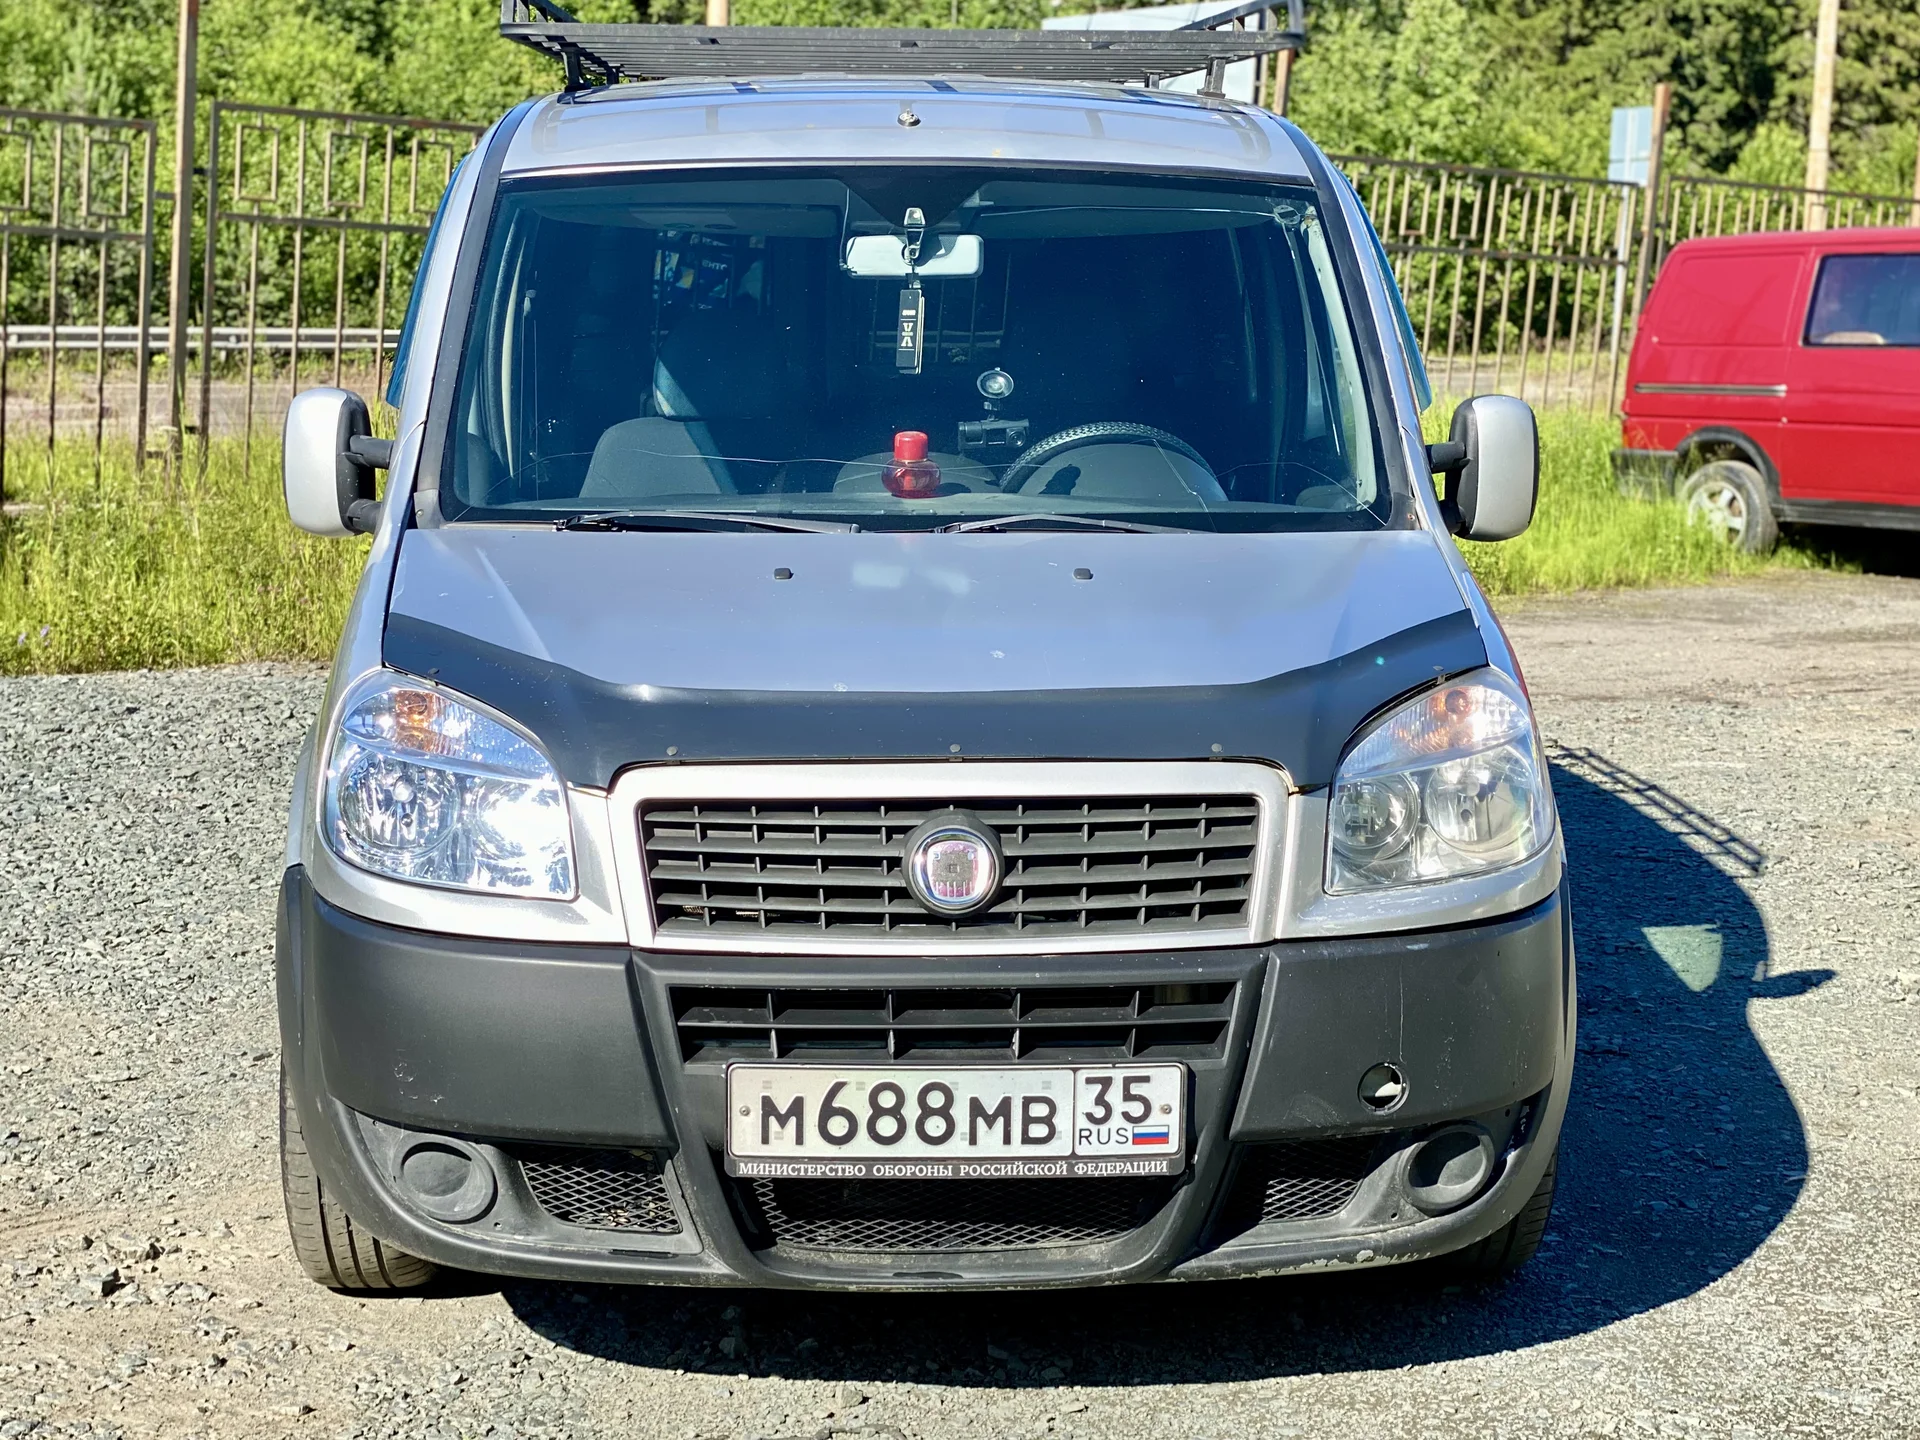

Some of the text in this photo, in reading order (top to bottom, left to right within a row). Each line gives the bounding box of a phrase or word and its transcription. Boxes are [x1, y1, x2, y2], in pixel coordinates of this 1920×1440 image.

[1084, 1075, 1153, 1125] 35
[1078, 1127, 1130, 1146] RUS
[738, 1160, 1168, 1177] МИНИСТЕРСТВО ОБОРОНЫ РОССИЙСКОЙ ФЕДЕРАЦИИ
